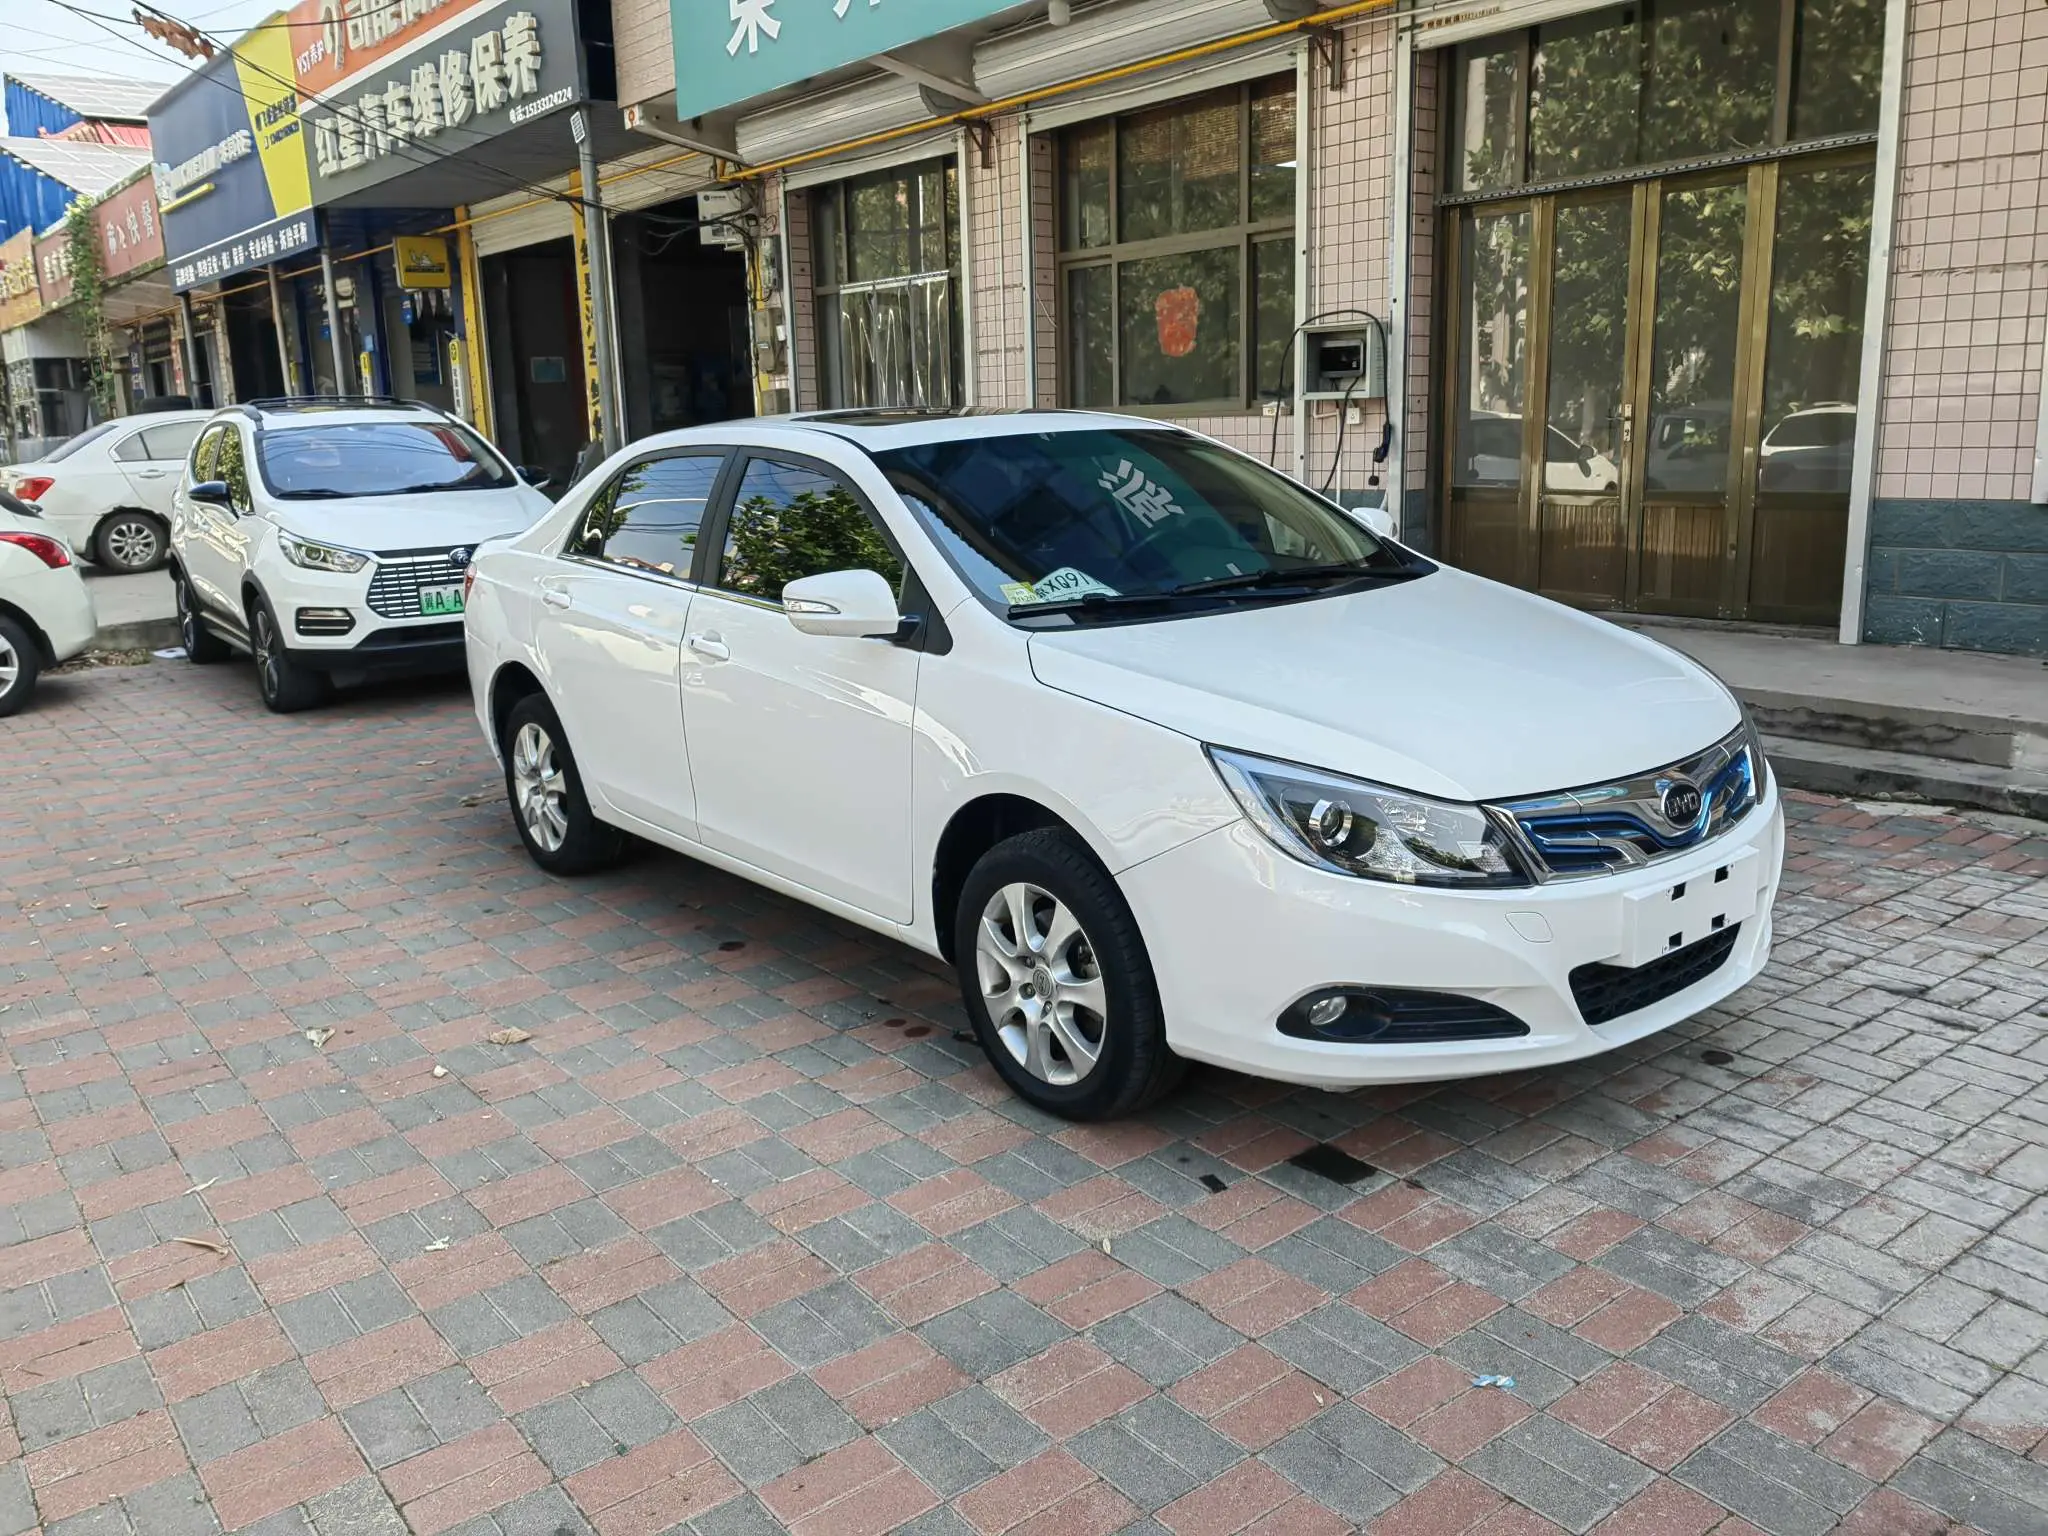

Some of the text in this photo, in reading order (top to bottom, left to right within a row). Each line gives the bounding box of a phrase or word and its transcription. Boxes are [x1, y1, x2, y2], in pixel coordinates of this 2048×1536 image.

[314, 11, 542, 178] 红星汽车维修保养
[1665, 791, 1699, 818] BYD
